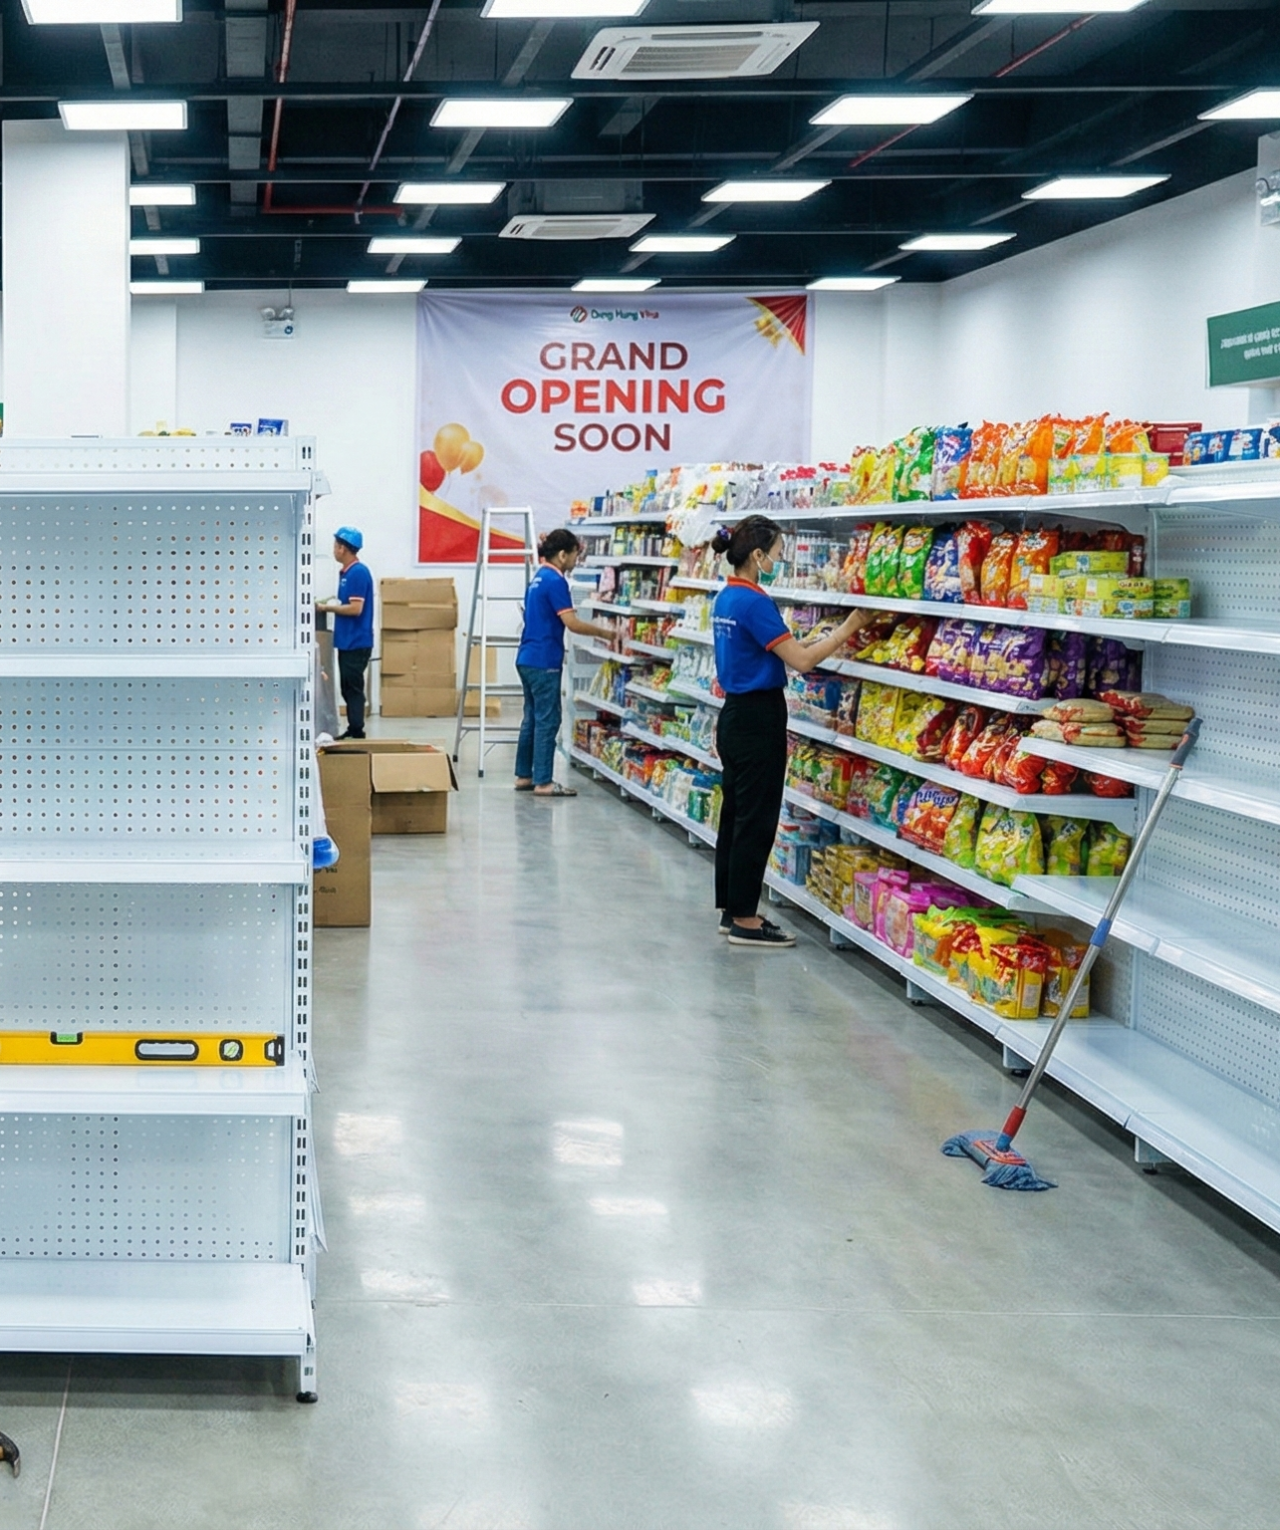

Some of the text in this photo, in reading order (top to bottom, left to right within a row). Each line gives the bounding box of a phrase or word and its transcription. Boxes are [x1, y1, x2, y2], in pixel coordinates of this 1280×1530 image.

[539, 341, 689, 371] GRAND
[500, 377, 726, 414] OPENING
[553, 422, 671, 452] SOON
